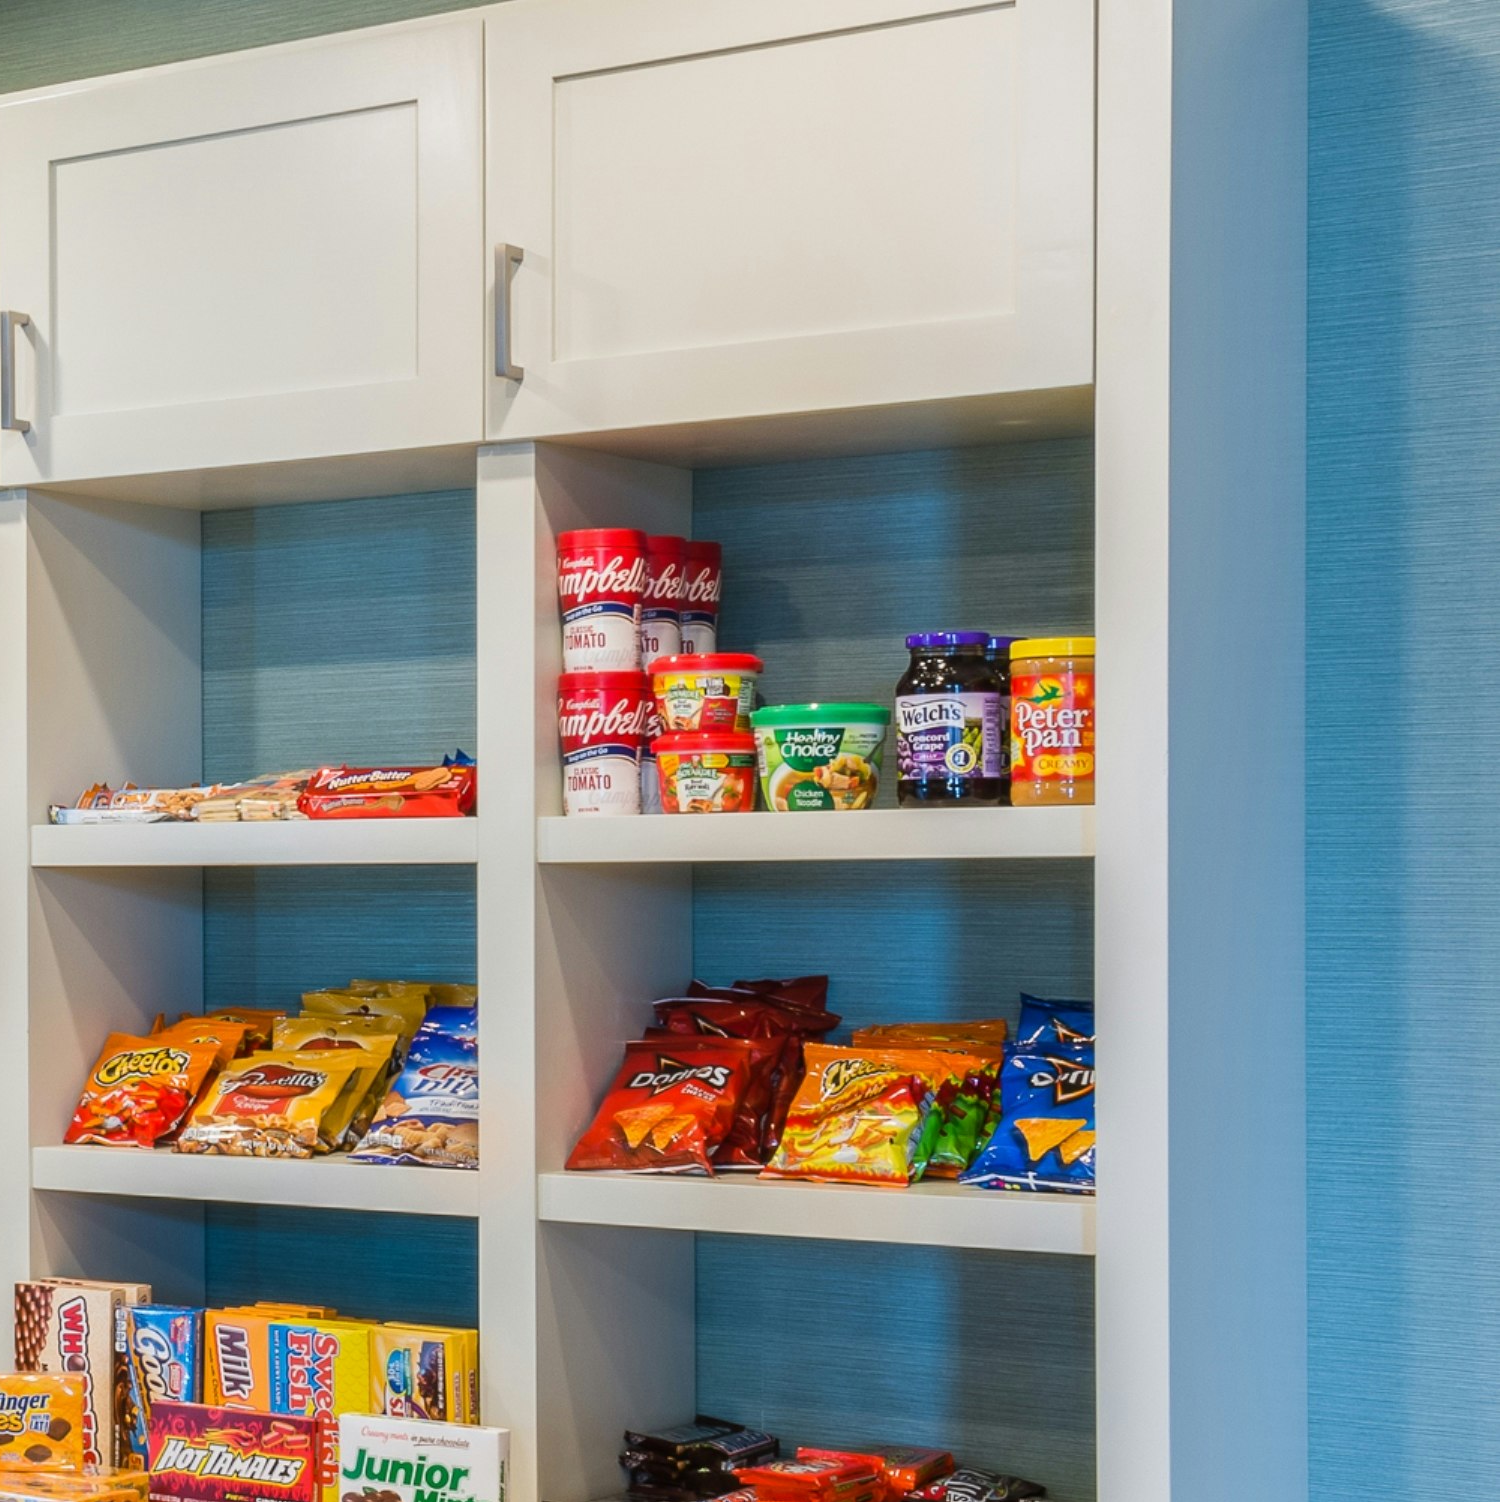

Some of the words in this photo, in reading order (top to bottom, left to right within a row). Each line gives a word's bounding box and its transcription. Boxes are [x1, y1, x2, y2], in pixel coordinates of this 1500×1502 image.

[566, 633, 606, 649] TOMATO
[902, 704, 961, 727] Welch's
[1016, 703, 1088, 730] Peter
[780, 740, 838, 758] Choice
[786, 728, 842, 747] Healthy
[907, 732, 950, 744] Concord
[913, 742, 945, 752] Grape
[1038, 755, 1090, 771] CREAMY
[568, 775, 611, 790] TOMATO
[794, 789, 825, 799] Chicken
[95, 1048, 191, 1086] Cheetos
[630, 1060, 729, 1090] Doritos
[216, 1325, 250, 1400] Milk
[288, 1331, 312, 1410] Fish
[361, 1425, 391, 1442] Creamy
[391, 1432, 409, 1442] mints
[411, 1434, 418, 1442] in
[419, 1435, 435, 1446] pure
[436, 1437, 470, 1448] chocolate
[155, 1439, 206, 1472] HOT
[201, 1445, 304, 1484] TAMALES
[343, 1449, 472, 1491] Junior
